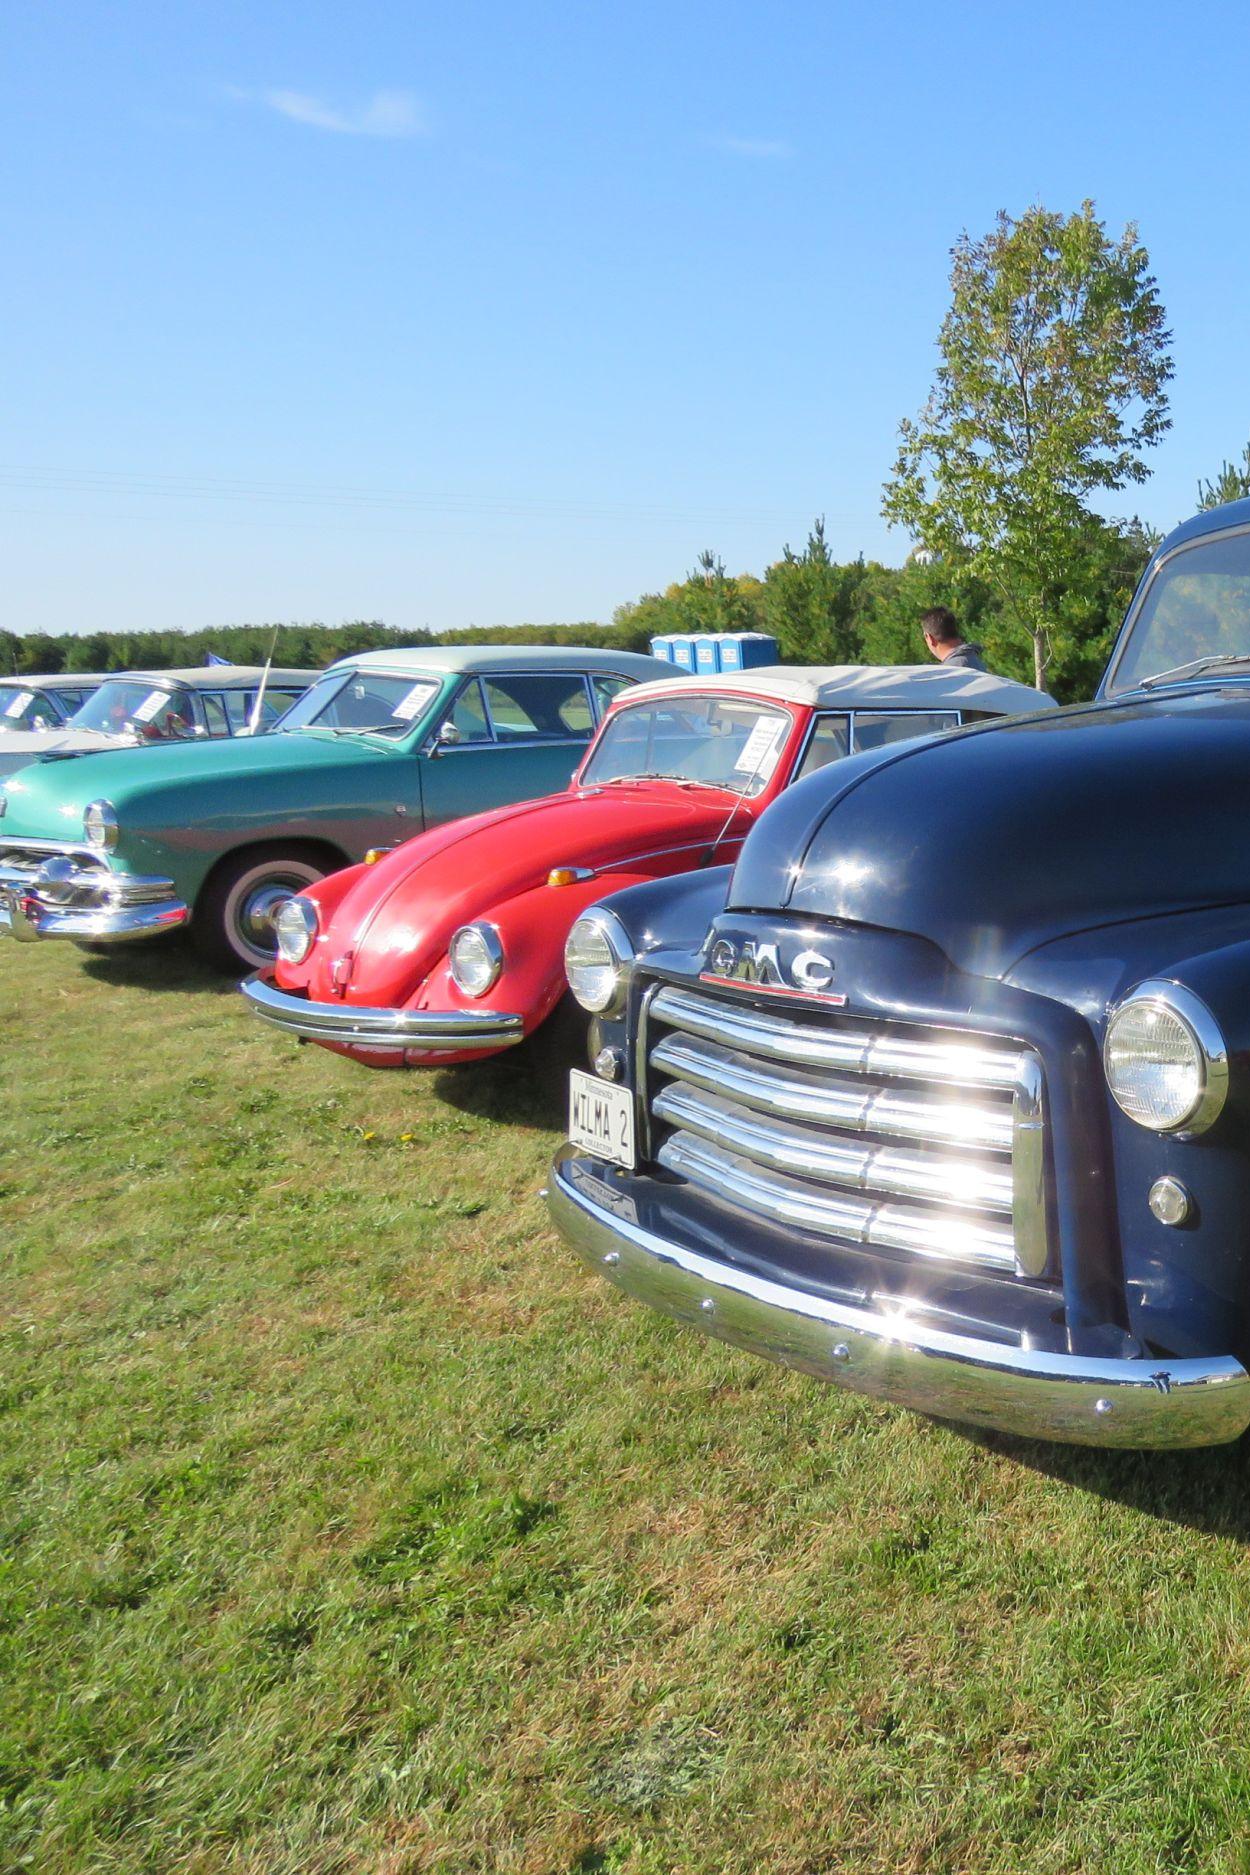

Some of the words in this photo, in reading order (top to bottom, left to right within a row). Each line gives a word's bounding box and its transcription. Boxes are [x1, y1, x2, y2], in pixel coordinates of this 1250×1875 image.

[711, 938, 835, 990] GMC
[573, 1090, 611, 1141] WILMA
[619, 1109, 629, 1148] 2
[584, 1137, 613, 1153] COLLECTOR
